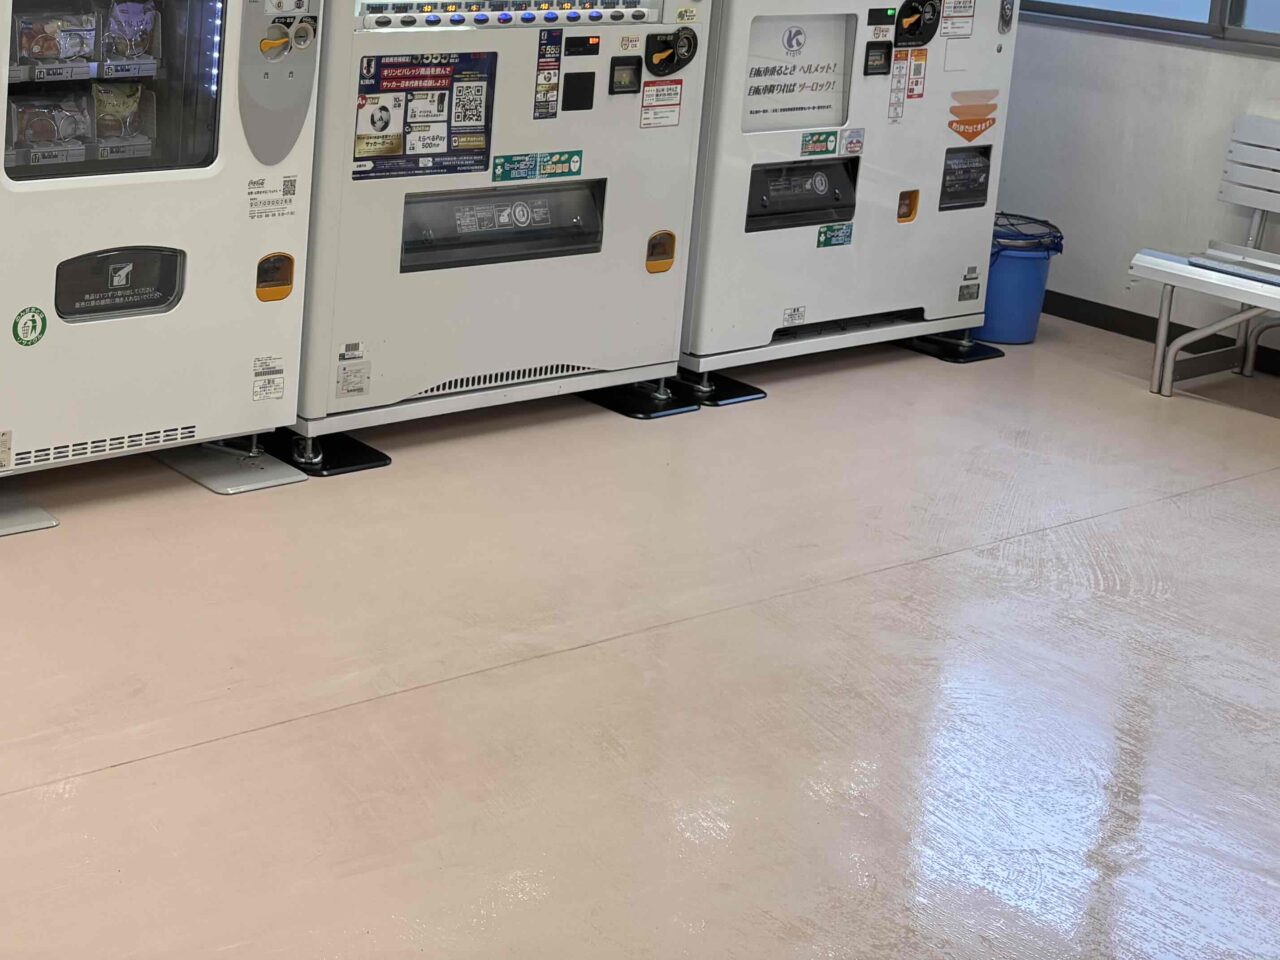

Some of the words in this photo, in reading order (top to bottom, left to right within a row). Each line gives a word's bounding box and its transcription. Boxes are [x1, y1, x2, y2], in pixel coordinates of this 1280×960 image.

[749, 63, 797, 78] 自転車乗るとき
[798, 62, 837, 75] ヘルメット!
[798, 80, 836, 94] ツーロック!
